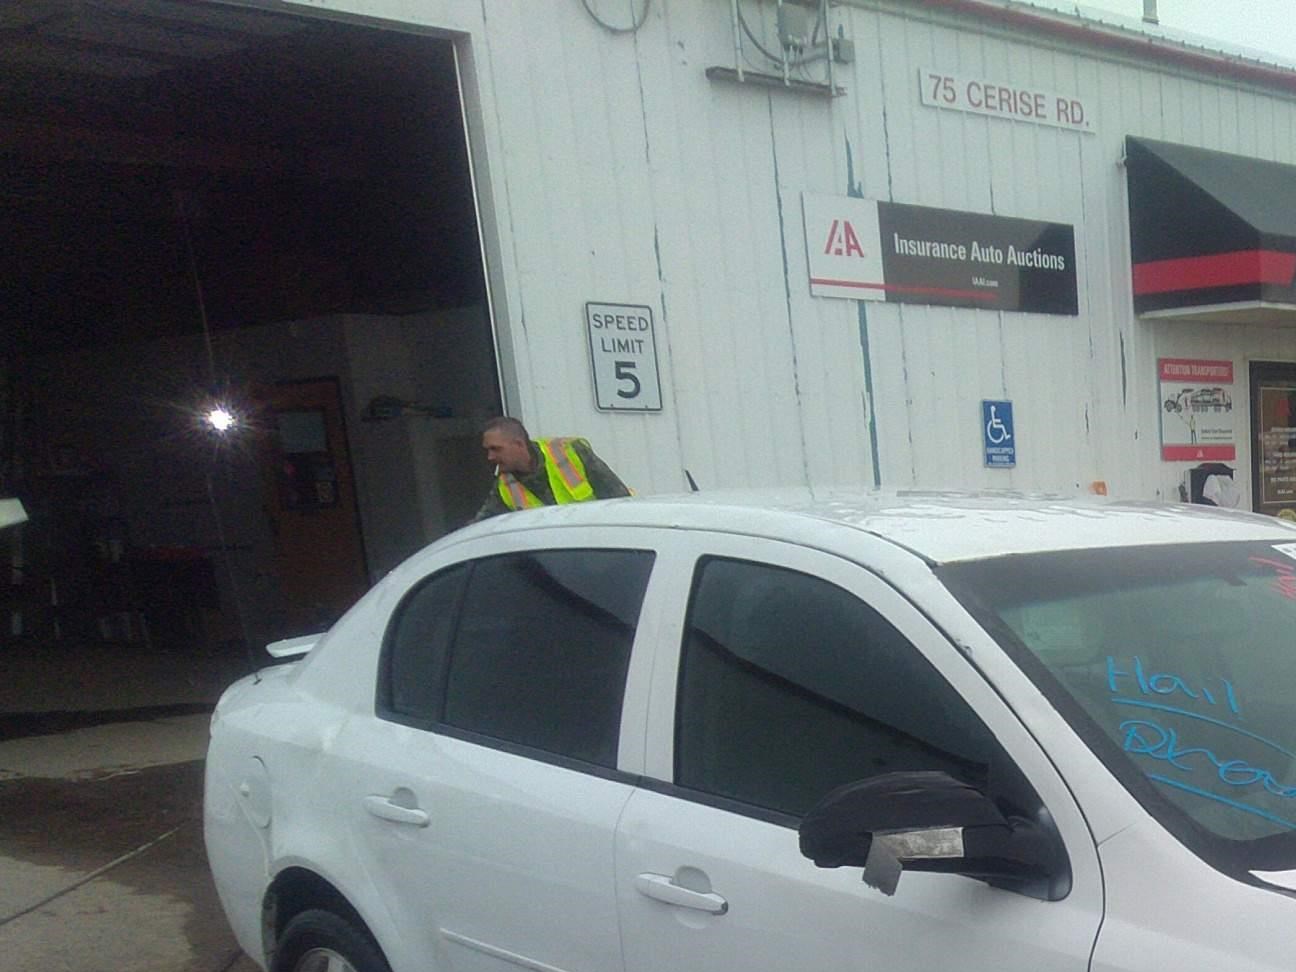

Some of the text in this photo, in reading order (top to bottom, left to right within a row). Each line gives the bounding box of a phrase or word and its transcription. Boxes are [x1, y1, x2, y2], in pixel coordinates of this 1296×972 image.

[929, 74, 1090, 127] 75 CERISE RD.
[893, 232, 1065, 271] Insurance Auto Auctions
[592, 313, 649, 331] SPEED
[601, 337, 645, 354] LIMIT
[614, 360, 641, 399] 5
